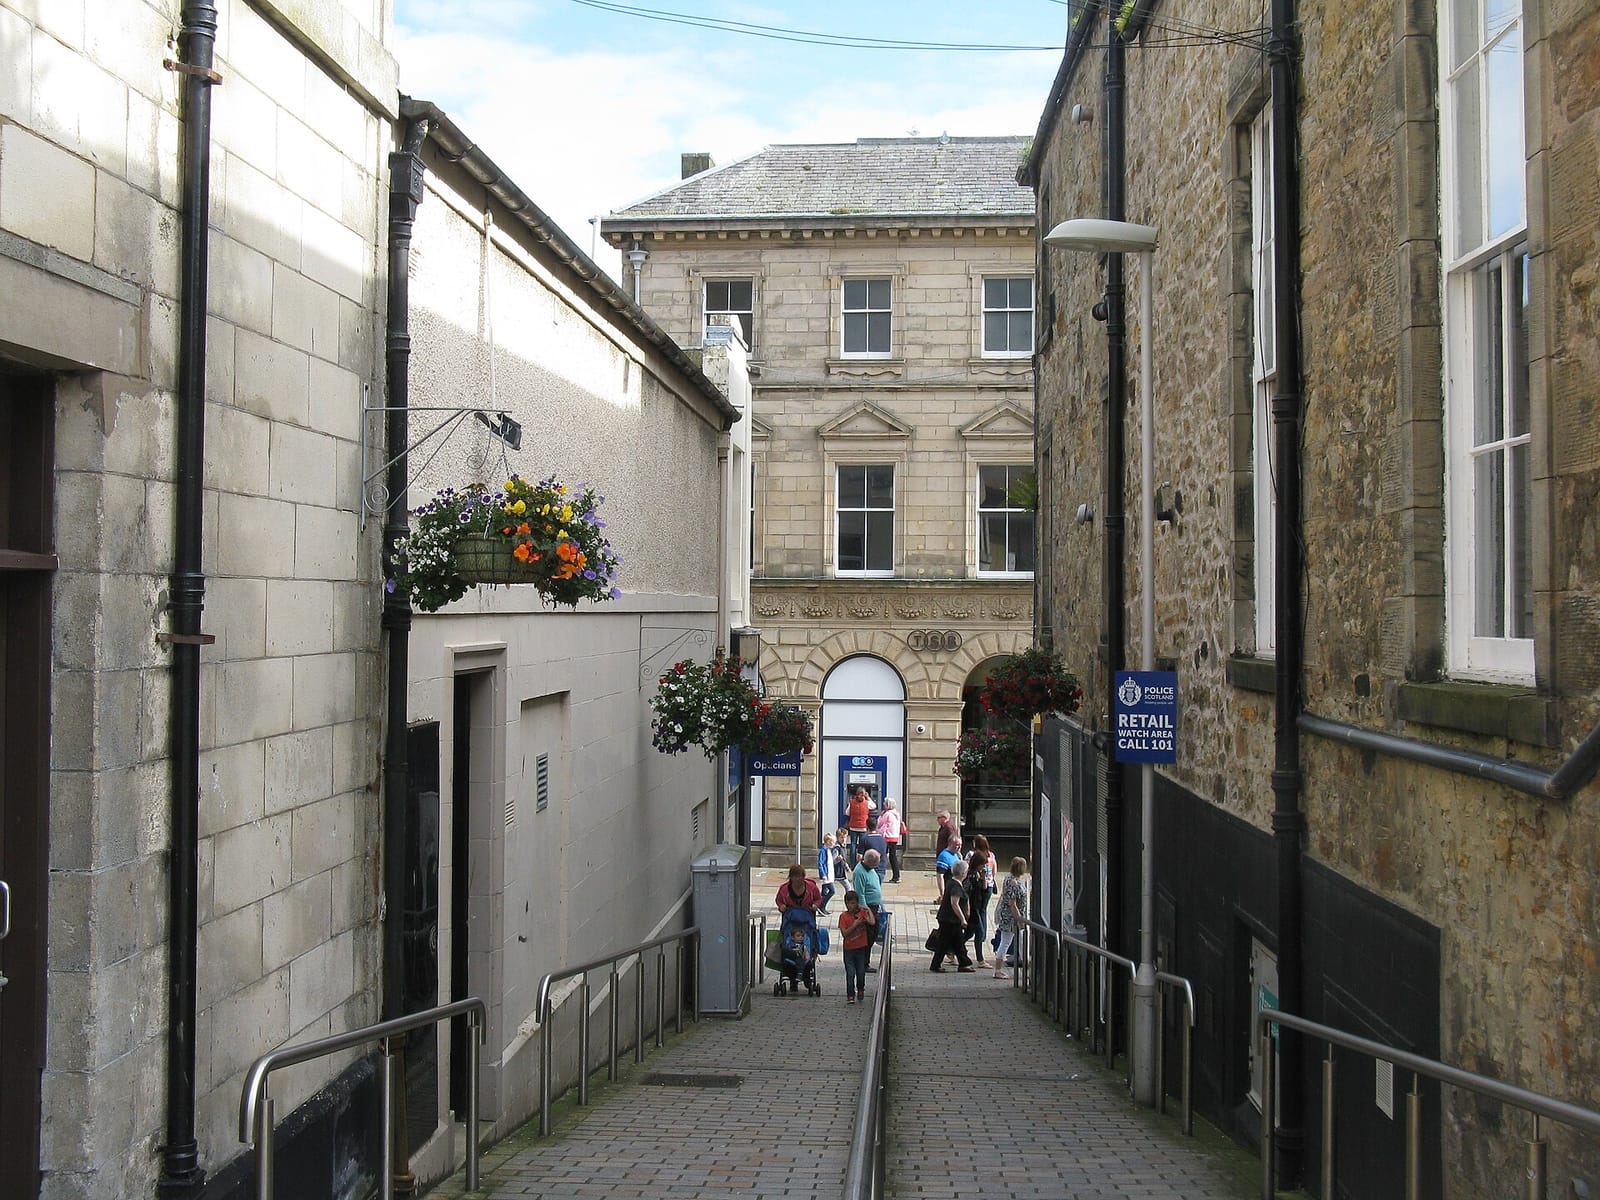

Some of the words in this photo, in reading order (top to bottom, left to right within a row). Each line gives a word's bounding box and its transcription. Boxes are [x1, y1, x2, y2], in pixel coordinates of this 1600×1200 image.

[1144, 687, 1174, 695] POLICE
[1118, 714, 1174, 728] RETAIL
[1118, 729, 1149, 738] WATCH
[1151, 730, 1173, 738] AREA
[1118, 739, 1149, 750] CALL
[1151, 740, 1174, 750] 101
[753, 760, 797, 770] Opcians
